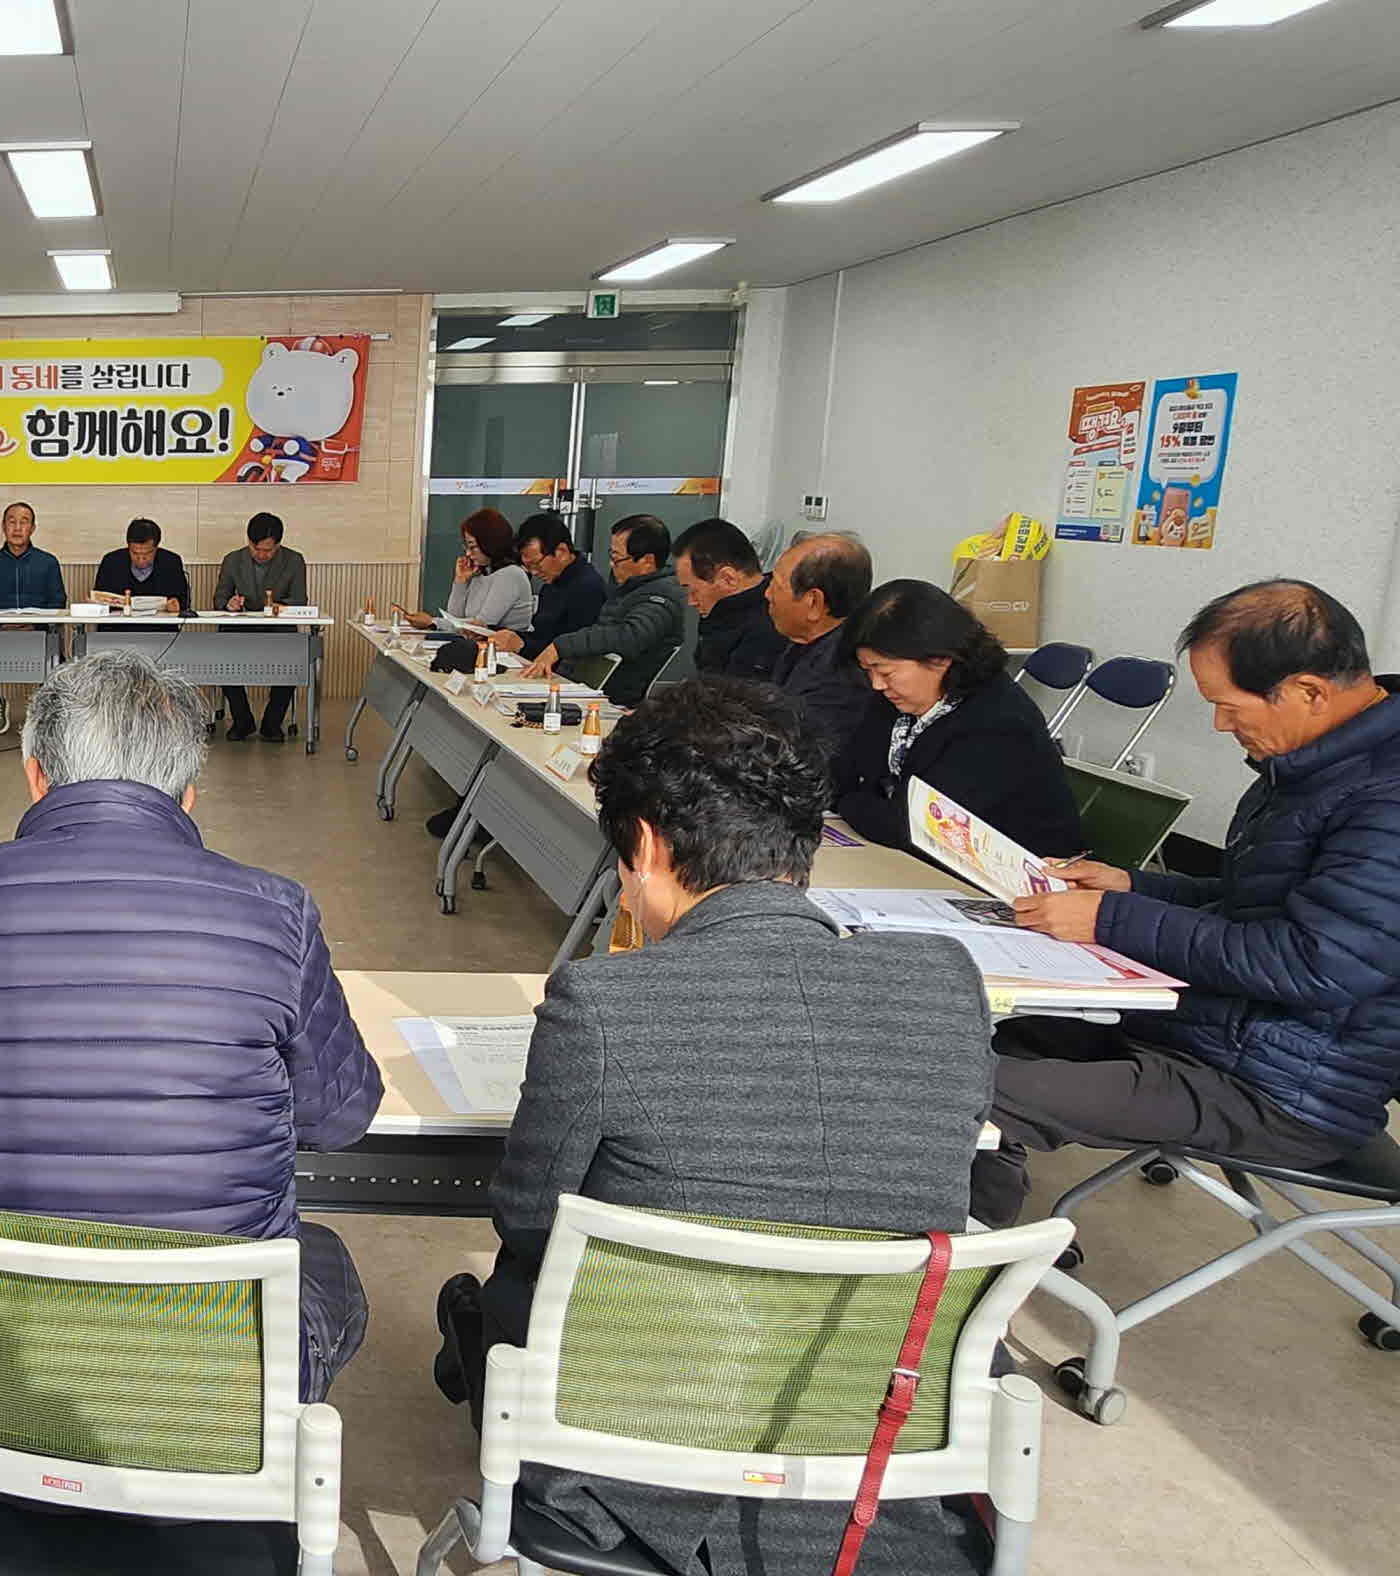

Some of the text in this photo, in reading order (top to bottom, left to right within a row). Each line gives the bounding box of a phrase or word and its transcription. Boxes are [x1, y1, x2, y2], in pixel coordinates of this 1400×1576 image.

[10, 365, 84, 390] 동네를
[90, 363, 192, 390] 살립니다
[26, 408, 230, 457] 함께해요!
[1160, 434, 1181, 448] 15%
